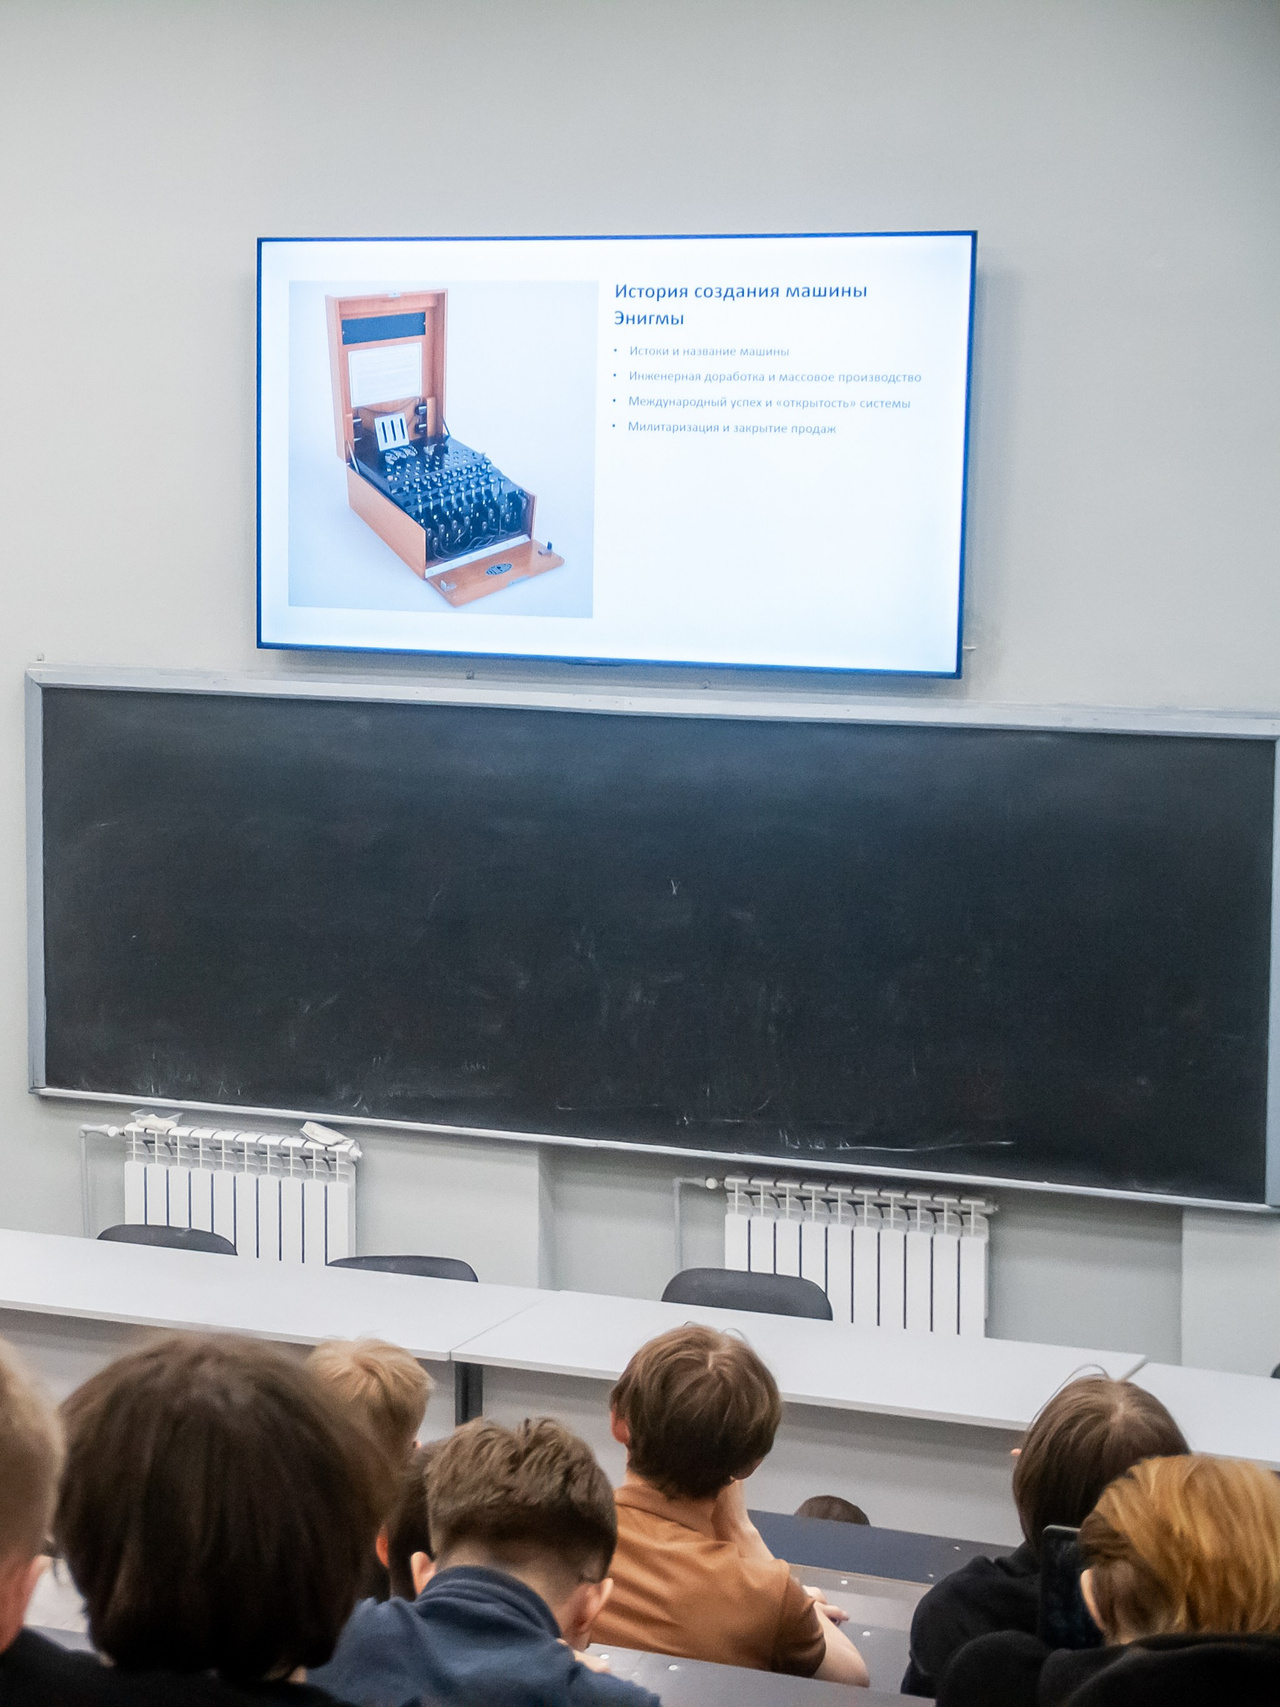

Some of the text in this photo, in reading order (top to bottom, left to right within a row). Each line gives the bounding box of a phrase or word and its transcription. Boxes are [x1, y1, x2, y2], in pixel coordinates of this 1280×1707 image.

[614, 283, 868, 302] История создания машины
[614, 310, 685, 326] Энигмы
[629, 345, 790, 357] Истоки и название машины
[628, 370, 923, 385] Инженерная доработка и массовое производство
[628, 395, 911, 411] Международный успех и «открытость» системы
[627, 420, 837, 437] Милитаризация и закрытие продаж
